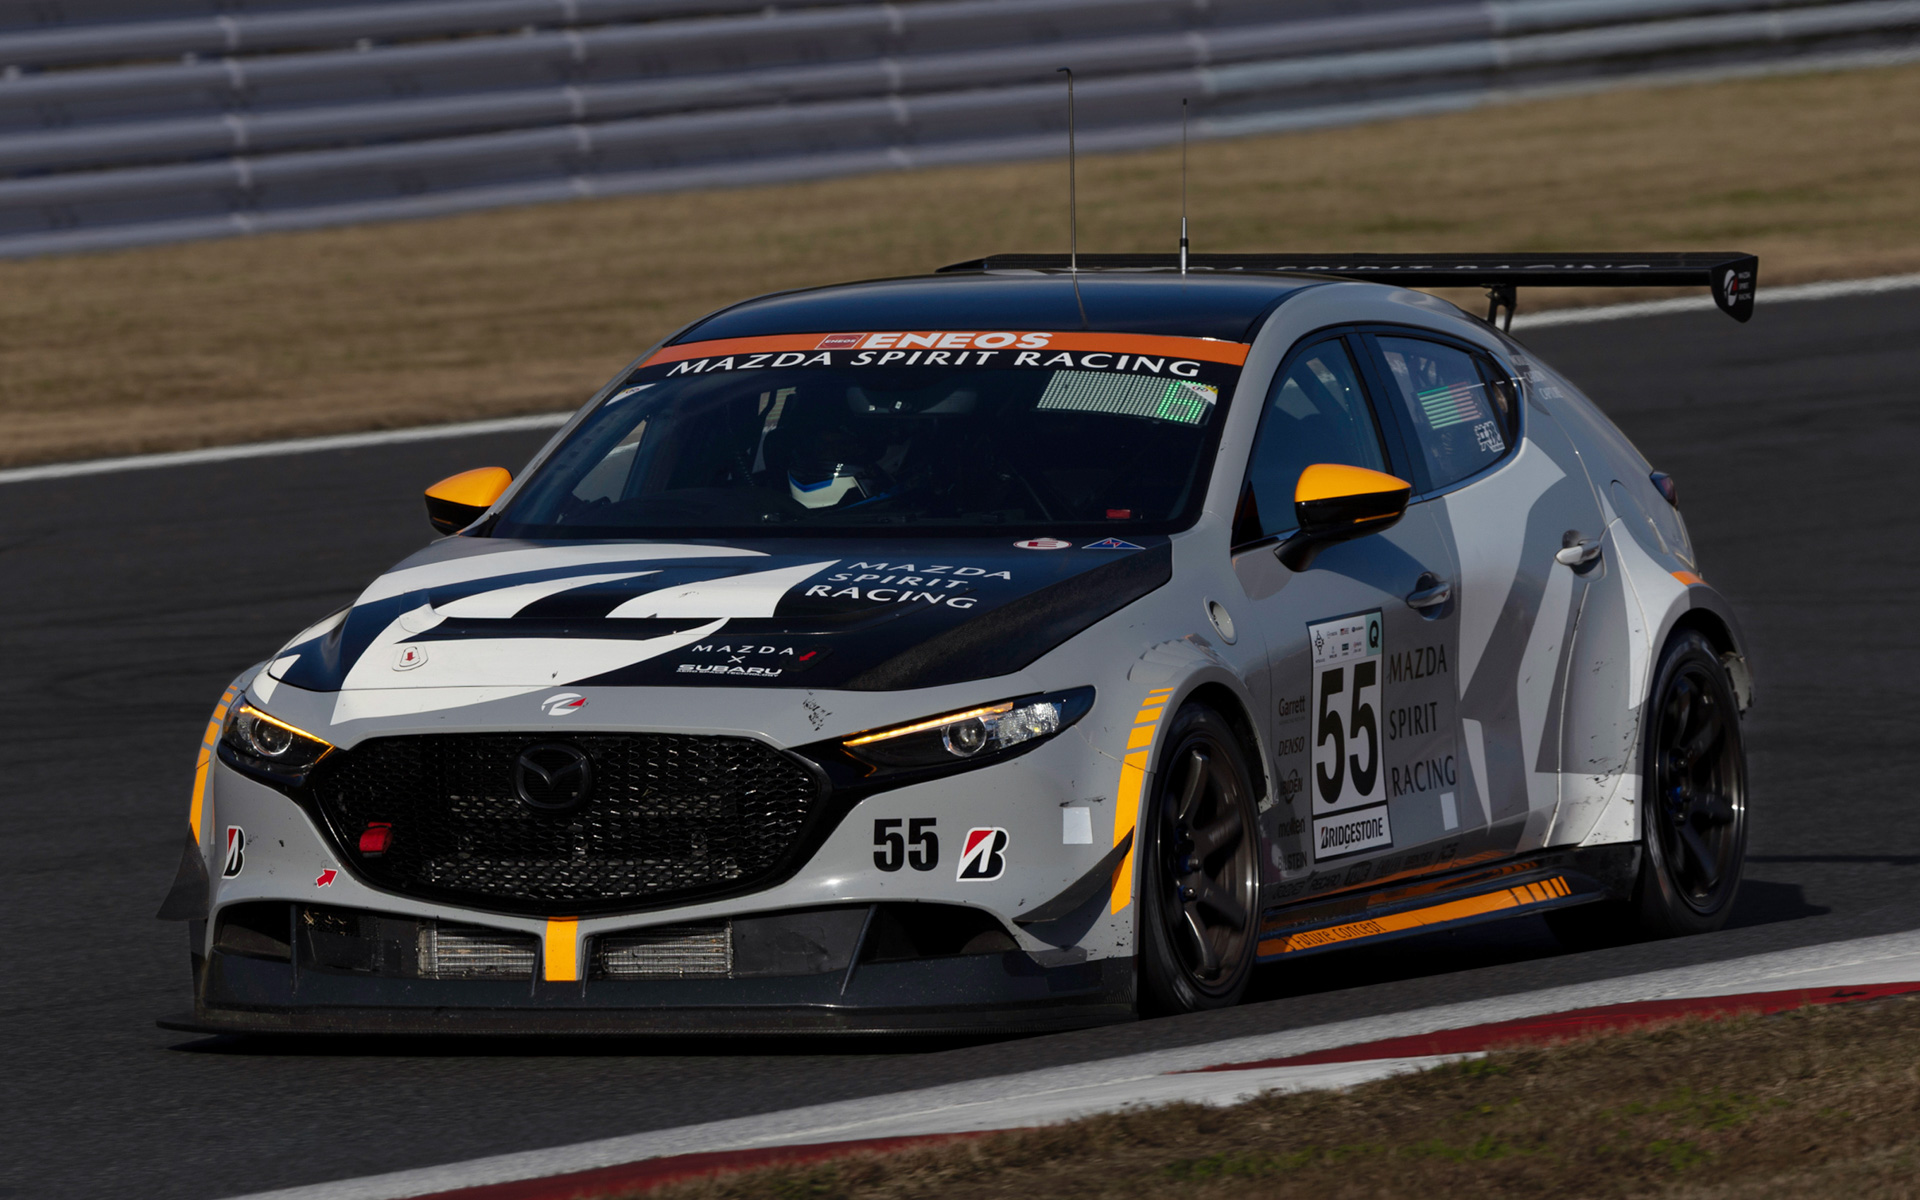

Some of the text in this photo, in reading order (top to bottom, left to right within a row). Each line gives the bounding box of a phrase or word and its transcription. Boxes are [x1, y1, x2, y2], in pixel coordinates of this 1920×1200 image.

[860, 332, 1053, 349] ENEOS
[666, 351, 1201, 377] MAZDA SPIRIT RACING
[827, 573, 969, 589] SPIRIT
[848, 561, 1012, 580] MAZDA
[804, 585, 978, 609] RACING
[1369, 619, 1380, 649] Q
[691, 644, 795, 656] MAZDA
[677, 663, 783, 675] SUBARU
[1388, 643, 1448, 685] MAZDA
[1278, 695, 1306, 717] Garrett
[1316, 660, 1379, 804] 55
[1389, 701, 1438, 741] SPIRIT
[1278, 735, 1305, 757] DENSO
[1392, 755, 1457, 797] RACING
[873, 817, 939, 872] 55
[1320, 816, 1384, 850] BRIDGESTONE
[1292, 918, 1387, 950] Future concept
